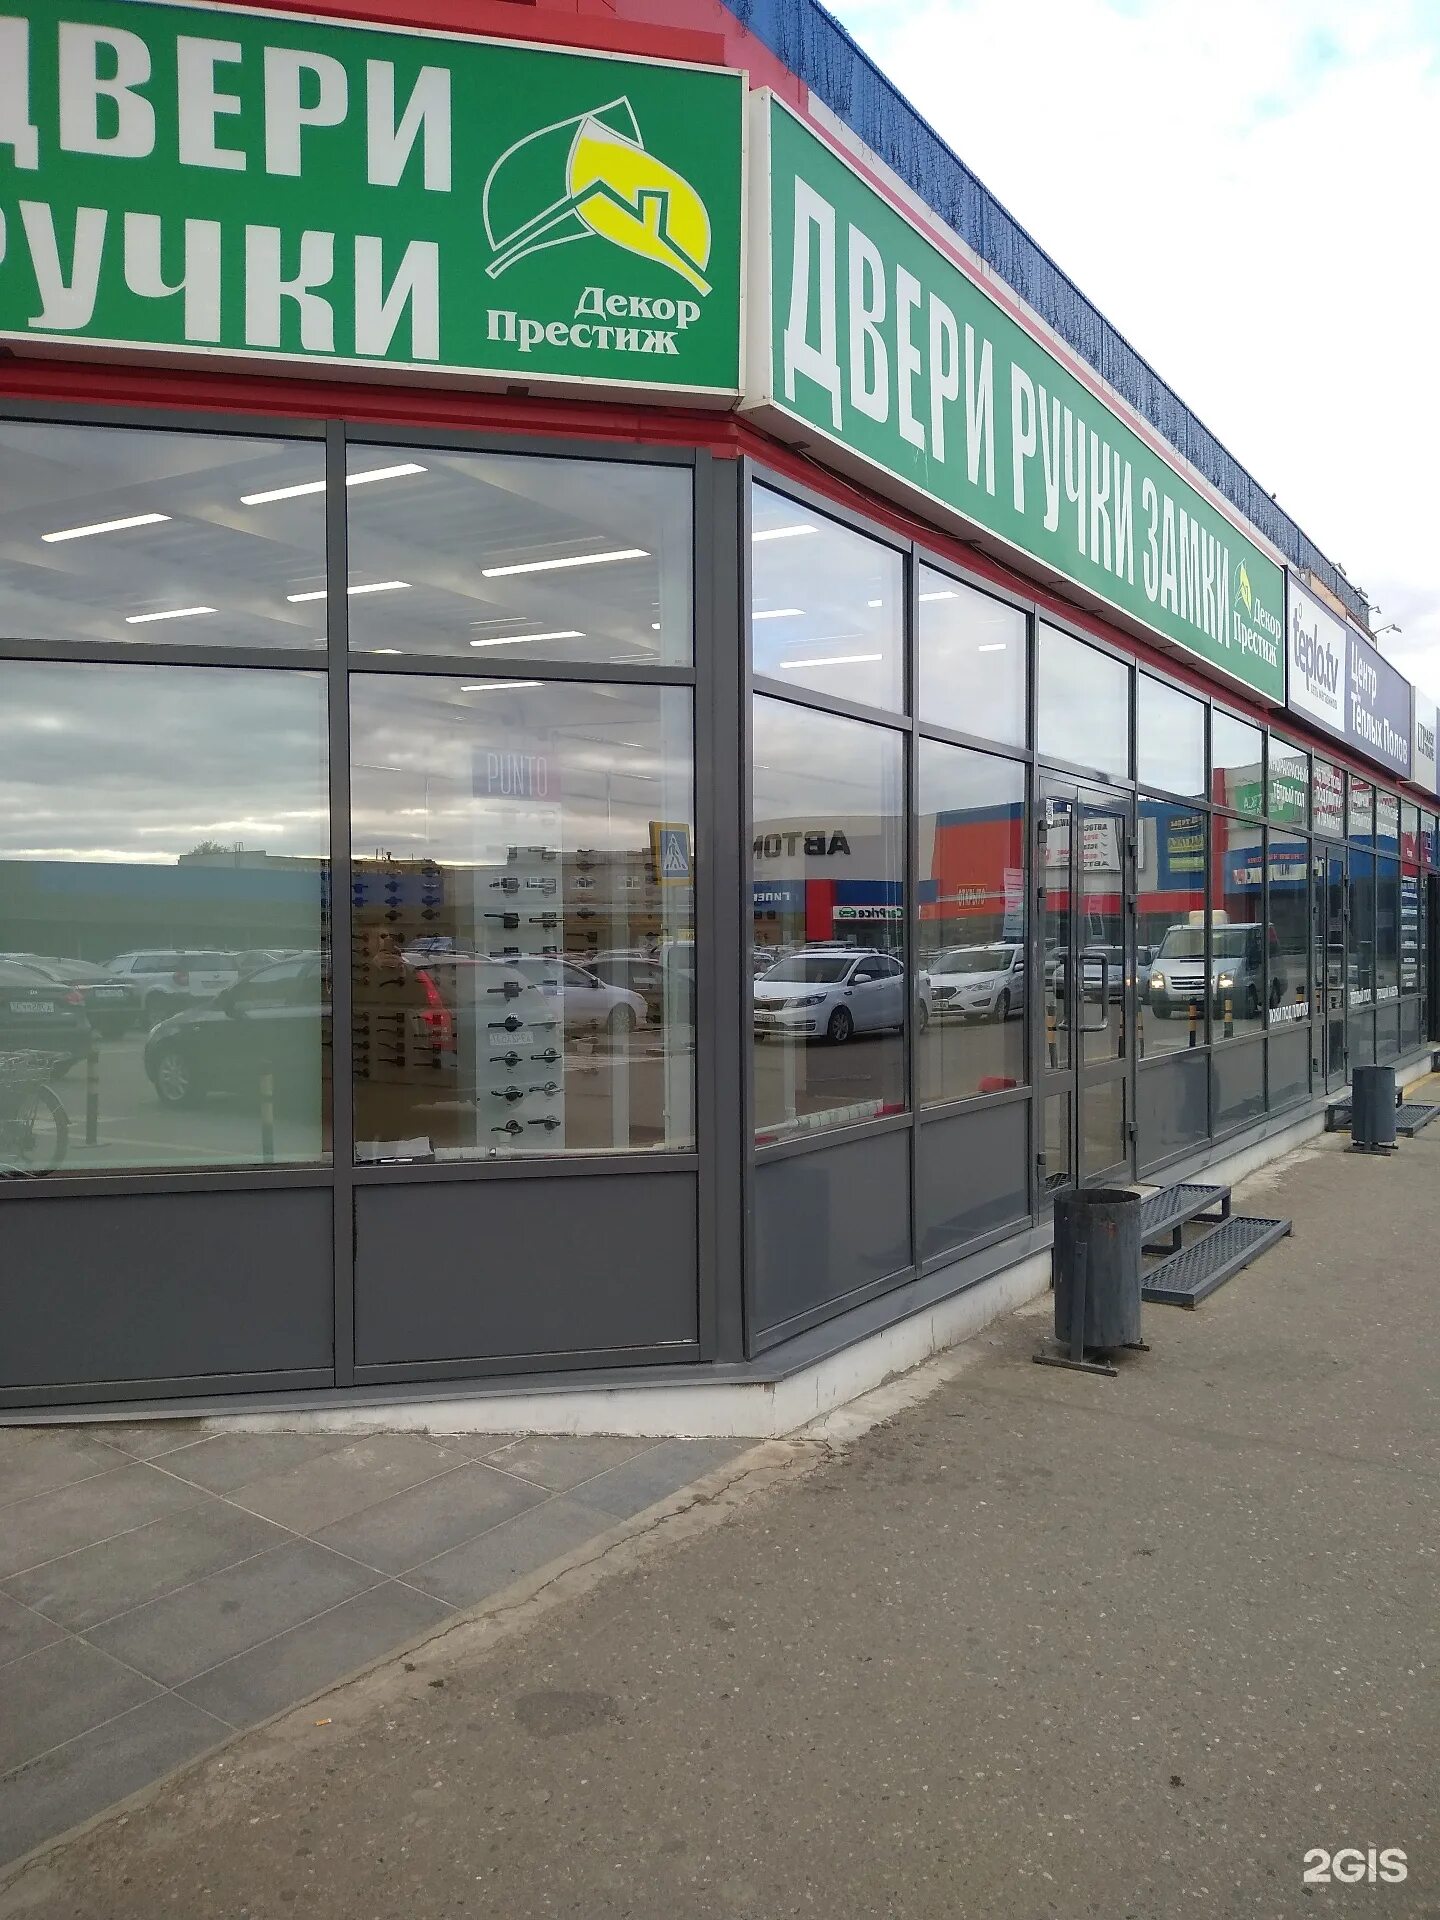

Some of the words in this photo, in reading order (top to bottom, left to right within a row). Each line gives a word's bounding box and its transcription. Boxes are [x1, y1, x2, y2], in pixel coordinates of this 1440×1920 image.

[0, 200, 440, 361] УЧКИ
[574, 287, 702, 331] Декор
[486, 308, 680, 356] Престиж
[784, 174, 996, 497] ДВЕРИ
[1010, 362, 1135, 585] РУЧКИ
[1142, 476, 1231, 649] ЗАМКИ
[1233, 610, 1278, 667] Престиж
[1253, 597, 1282, 645] Декор
[1291, 606, 1339, 694] teplo.tv
[1351, 641, 1377, 706] Центр
[1350, 690, 1383, 748] Тёплых
[1383, 717, 1408, 765] Полов
[487, 752, 548, 797] PUNTO
